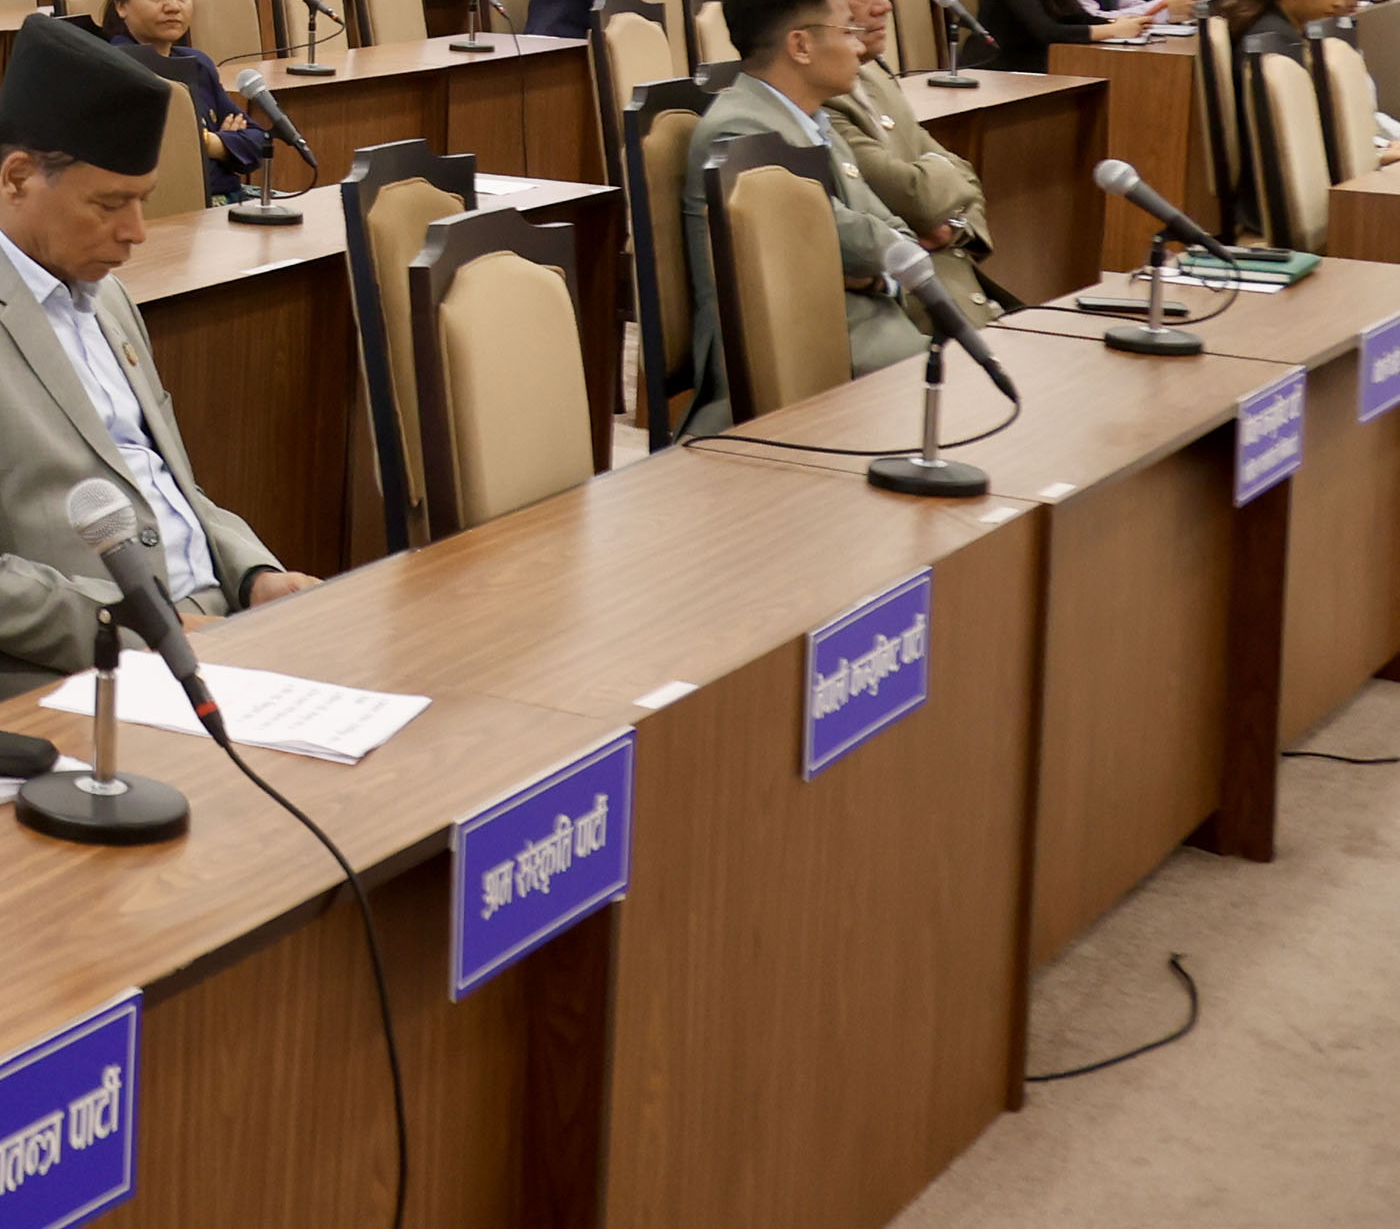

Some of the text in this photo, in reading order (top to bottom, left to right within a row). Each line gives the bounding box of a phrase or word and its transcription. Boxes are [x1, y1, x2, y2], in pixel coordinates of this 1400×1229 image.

[481, 794, 609, 921] श्रम संस्कृति पार्टी
[68, 1063, 123, 1150] पार्टी
